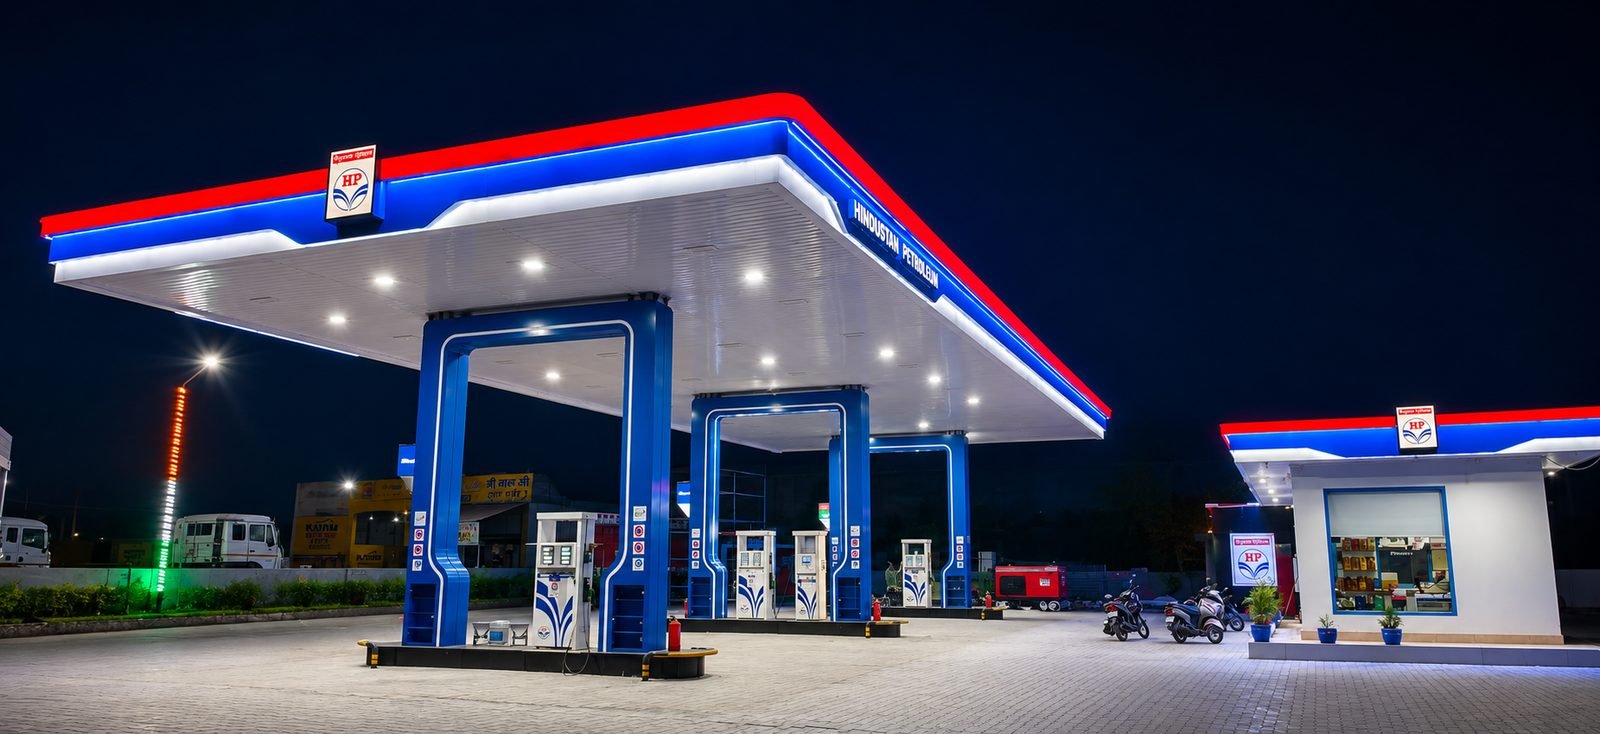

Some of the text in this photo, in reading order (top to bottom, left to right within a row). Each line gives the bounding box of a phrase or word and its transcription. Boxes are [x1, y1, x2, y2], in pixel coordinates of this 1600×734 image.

[342, 173, 362, 187] HP
[854, 199, 899, 254] HINDUSTAN
[1409, 421, 1425, 430] HP
[1245, 553, 1262, 562] HP
